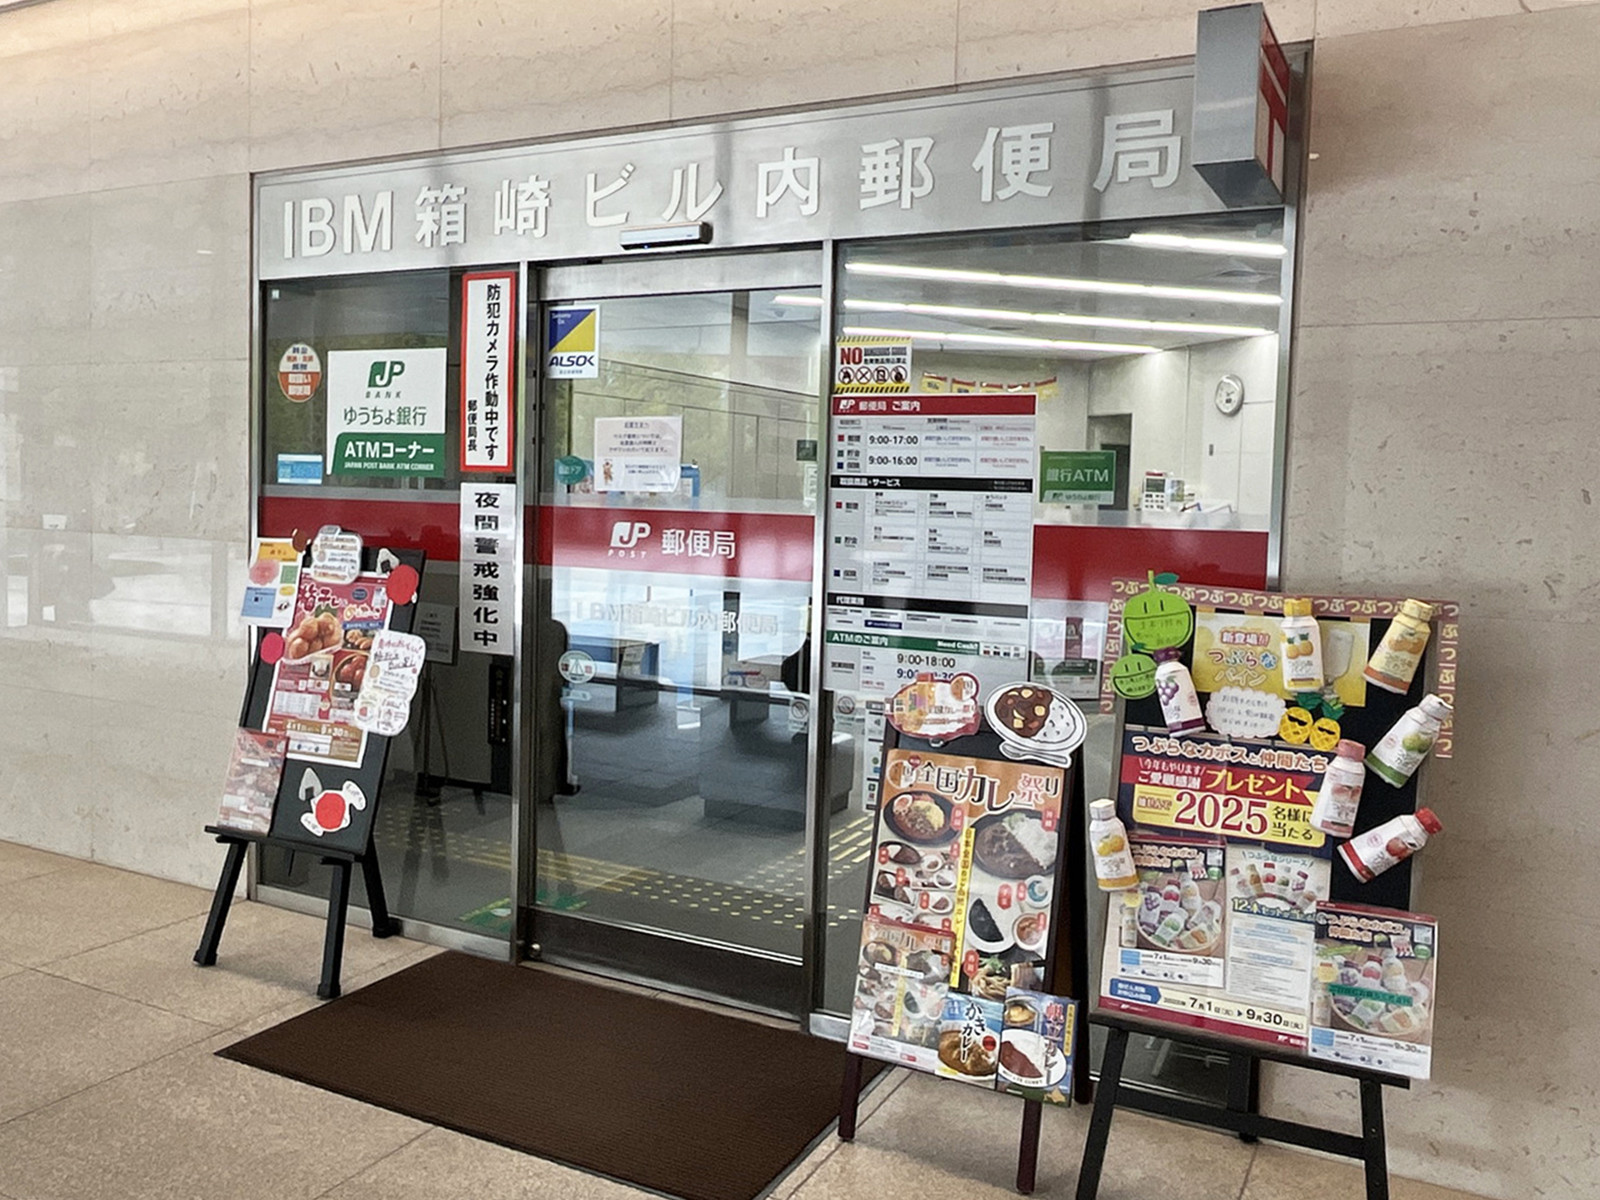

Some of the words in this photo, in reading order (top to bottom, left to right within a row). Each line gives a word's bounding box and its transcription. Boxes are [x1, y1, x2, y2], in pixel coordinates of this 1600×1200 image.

[283, 109, 1182, 259] IBM箱崎ビル内郵便局
[549, 355, 595, 367] ALSOK
[841, 347, 863, 365] NO
[367, 360, 406, 388] JP
[485, 284, 501, 461] 防犯カメラ作動中です
[365, 390, 402, 399] BANK
[859, 401, 887, 411] 郵便局
[892, 401, 921, 412] ご案内
[343, 405, 427, 427] ゆうちょ銀行
[467, 400, 478, 451] 郵便局長
[869, 435, 919, 445] 9:00-17:00
[344, 441, 435, 459] ATMコーナー
[363, 462, 378, 470] POST
[396, 462, 411, 471] ATM
[869, 455, 918, 466] 9:00-16:00
[1046, 468, 1109, 482] 銀行ATM
[610, 521, 652, 548] JP
[662, 529, 736, 559] 郵便局
[608, 549, 648, 559] POST
[473, 491, 500, 648] 夜間警戒強化中
[832, 632, 889, 647] ATMのご案内
[897, 653, 956, 668] 9:00-18:00
[1208, 650, 1276, 669] つぶらな
[1215, 668, 1267, 686] パイン
[1132, 736, 1329, 774] つぶらなカボスと仲間たち
[1143, 759, 1202, 775] 今年もやります
[1205, 769, 1301, 800] プレゼント
[1174, 790, 1268, 835] 2025
[1273, 806, 1312, 825] 名様に
[1272, 823, 1313, 840] 当たる
